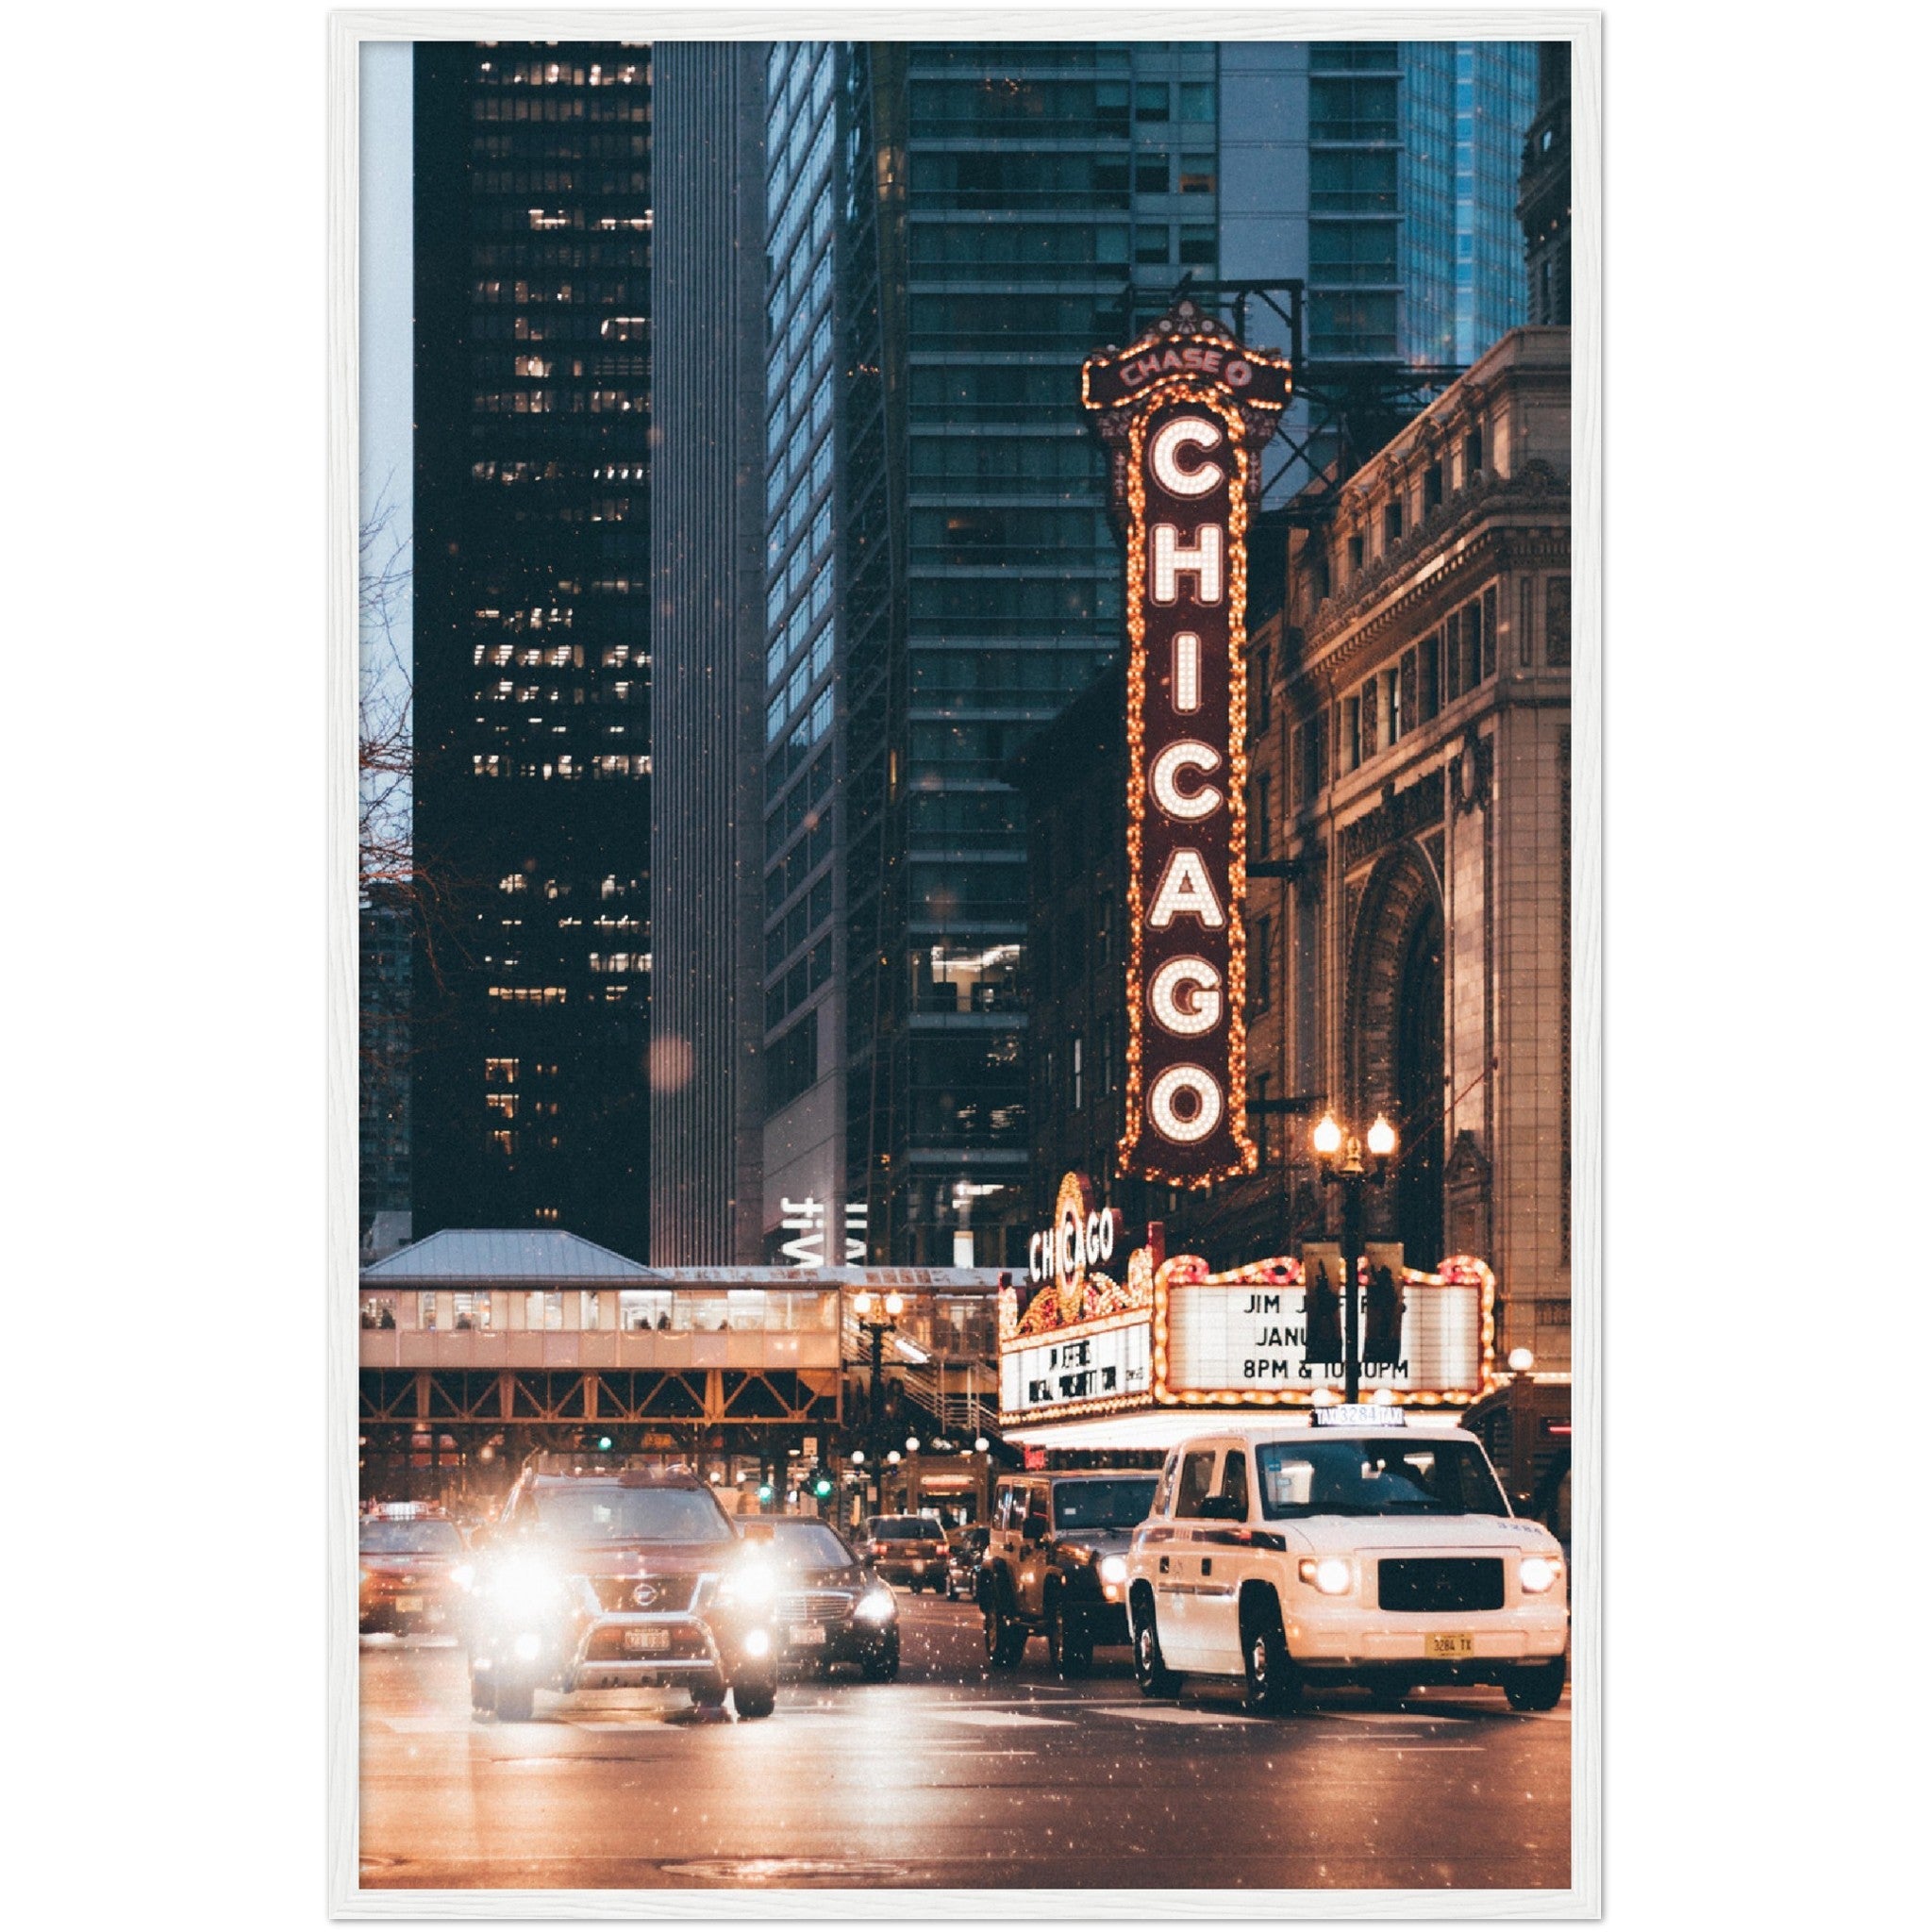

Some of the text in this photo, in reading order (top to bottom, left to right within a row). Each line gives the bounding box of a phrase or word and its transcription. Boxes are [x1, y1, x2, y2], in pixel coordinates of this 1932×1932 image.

[1119, 347, 1224, 388] CHASE
[1146, 415, 1225, 1146] CHICAGO
[1029, 1206, 1115, 1283] CHICAGO
[1243, 1294, 1281, 1314] JIM
[1243, 1359, 1409, 1379] 8PM & 100PM
[1340, 1406, 1377, 1423] 3284
